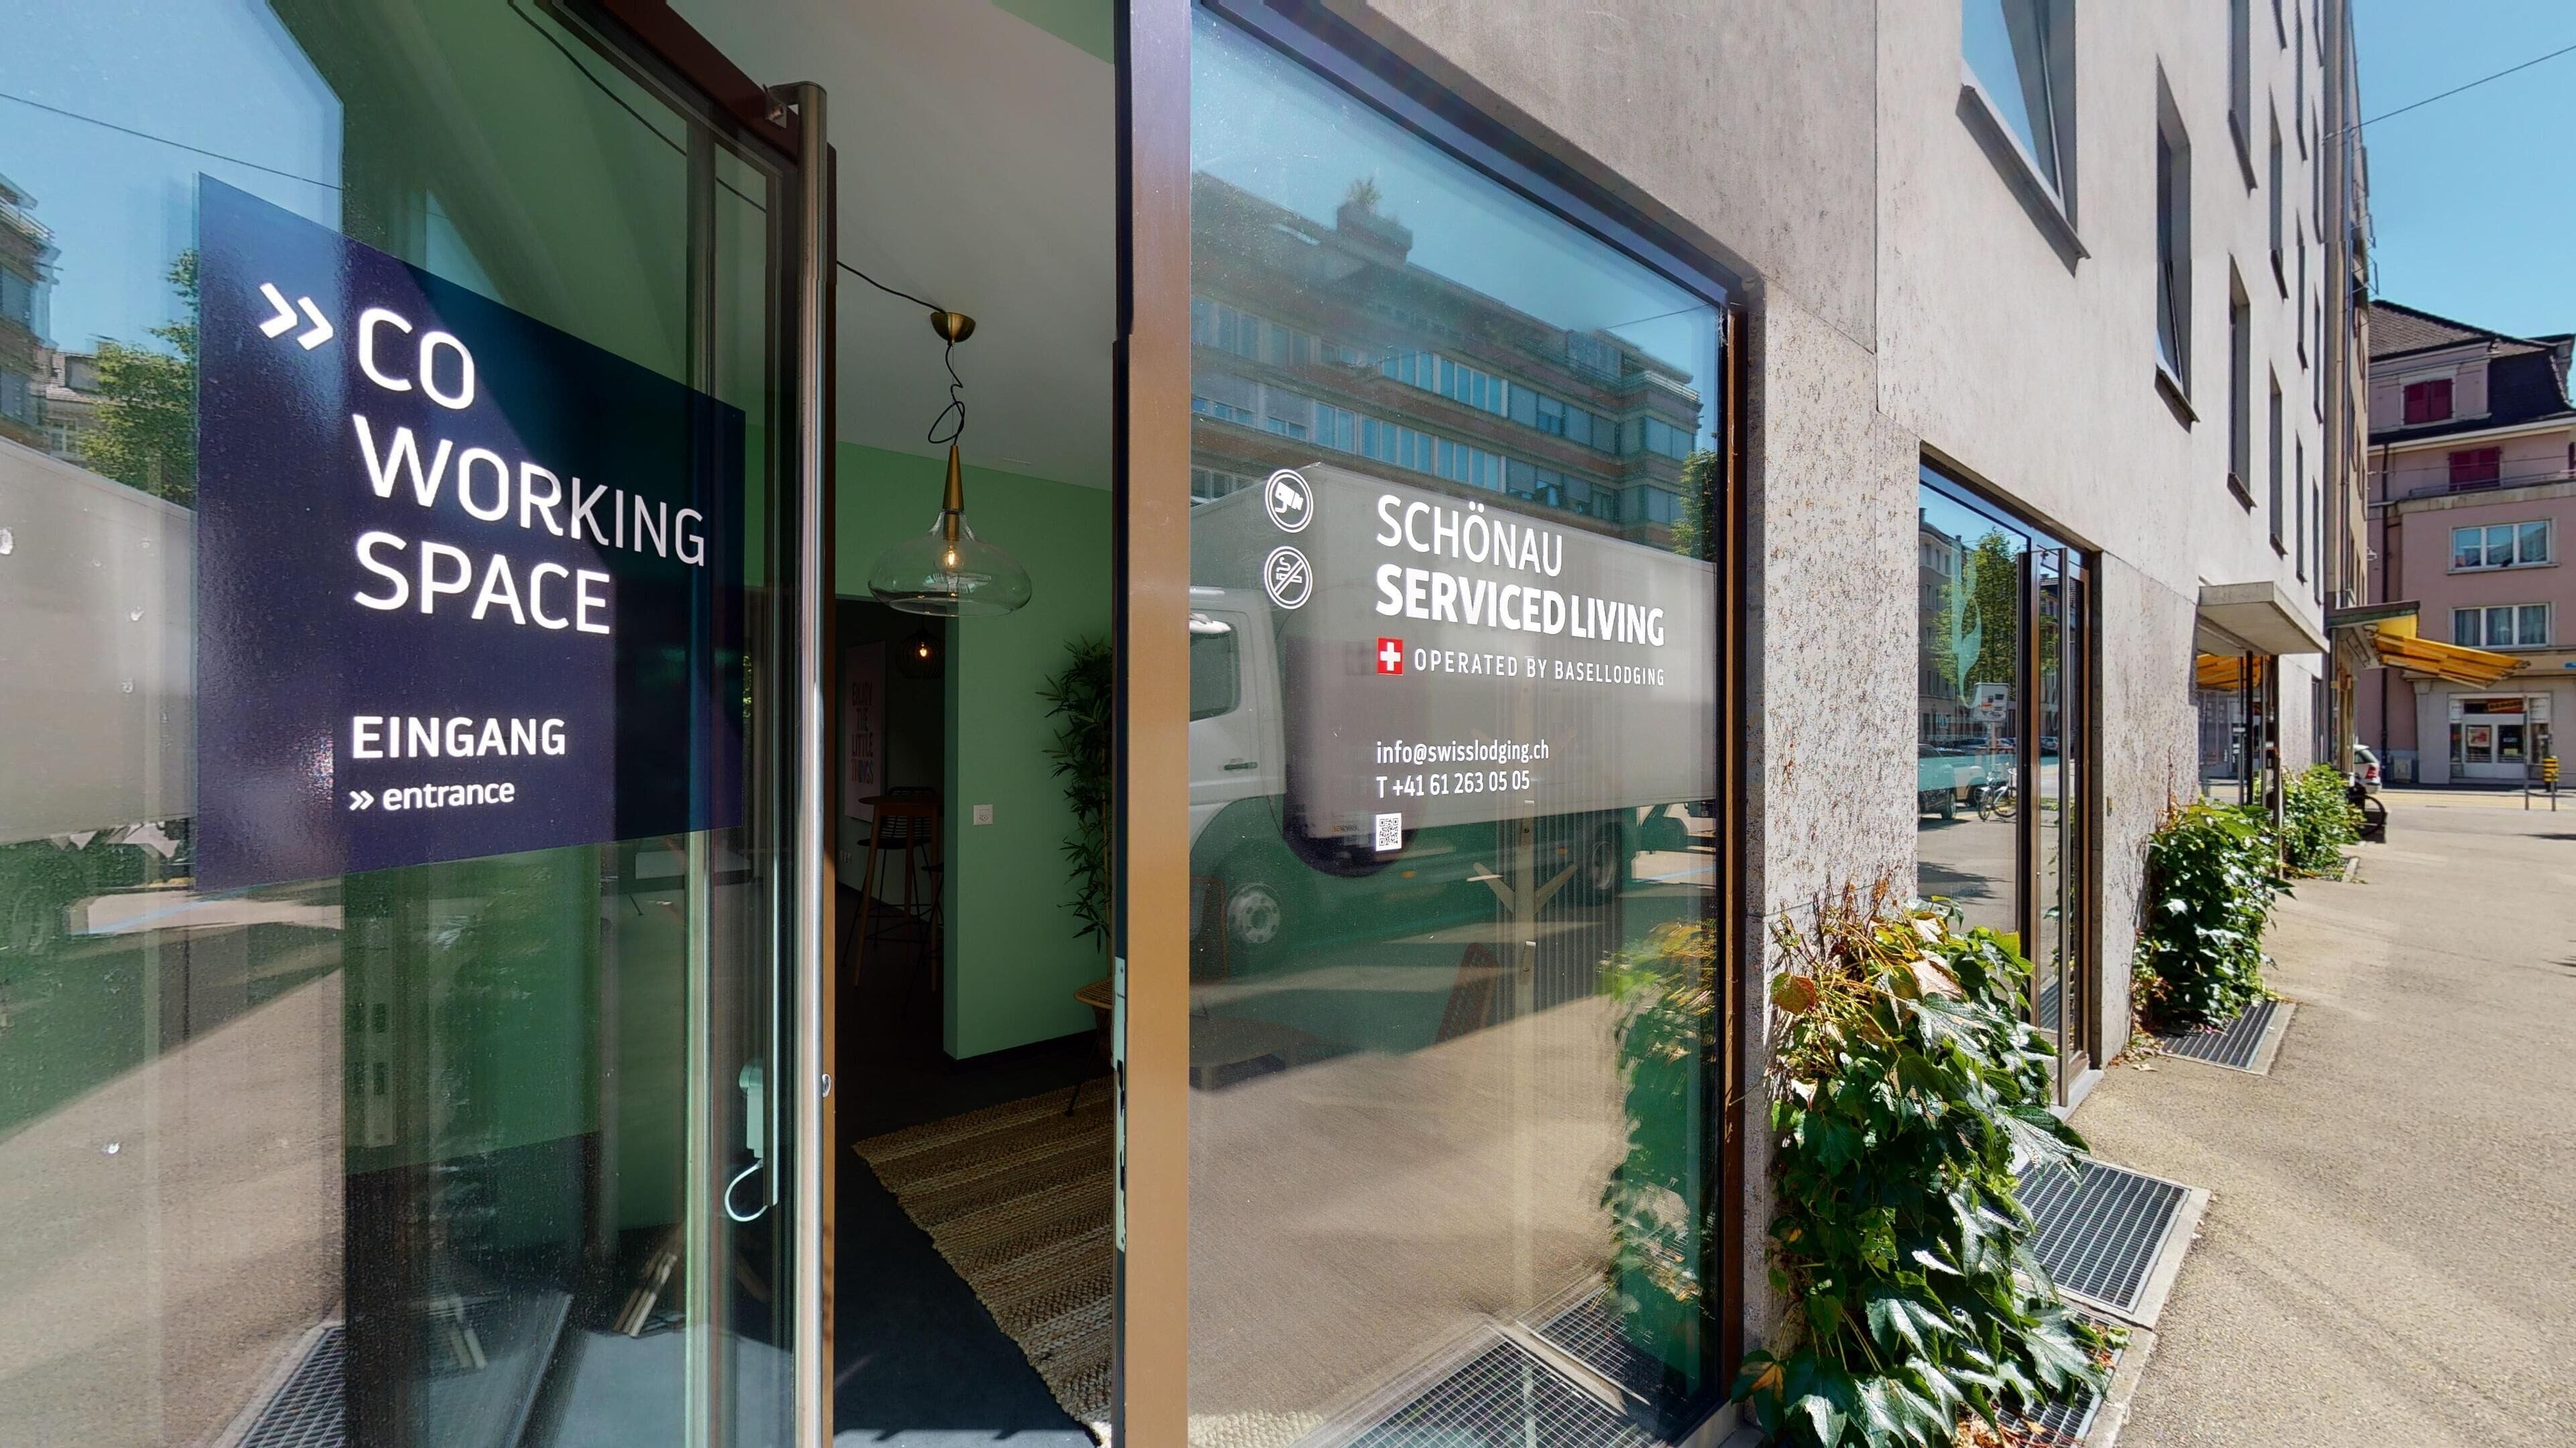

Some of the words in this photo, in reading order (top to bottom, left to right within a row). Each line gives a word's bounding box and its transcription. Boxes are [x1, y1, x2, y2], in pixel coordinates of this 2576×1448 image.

[358, 307, 476, 410] CO
[352, 412, 705, 567] WORKING
[1375, 494, 1563, 577] SCHÖNAU
[354, 530, 611, 635] SPACE
[1413, 647, 1518, 678] OPERATED
[1525, 655, 1548, 679] BY
[1554, 659, 1665, 687] BASELLODGING
[352, 715, 567, 759] EINGANG
[1376, 738, 1550, 765] info@swisslodging.ch
[382, 781, 516, 812] entrance
[1376, 776, 1388, 799] T
[1392, 775, 1425, 797] +41
[1430, 773, 1450, 795] 61
[1454, 771, 1484, 794] 263
[1489, 771, 1507, 792] 05
[1511, 770, 1531, 791] 05
